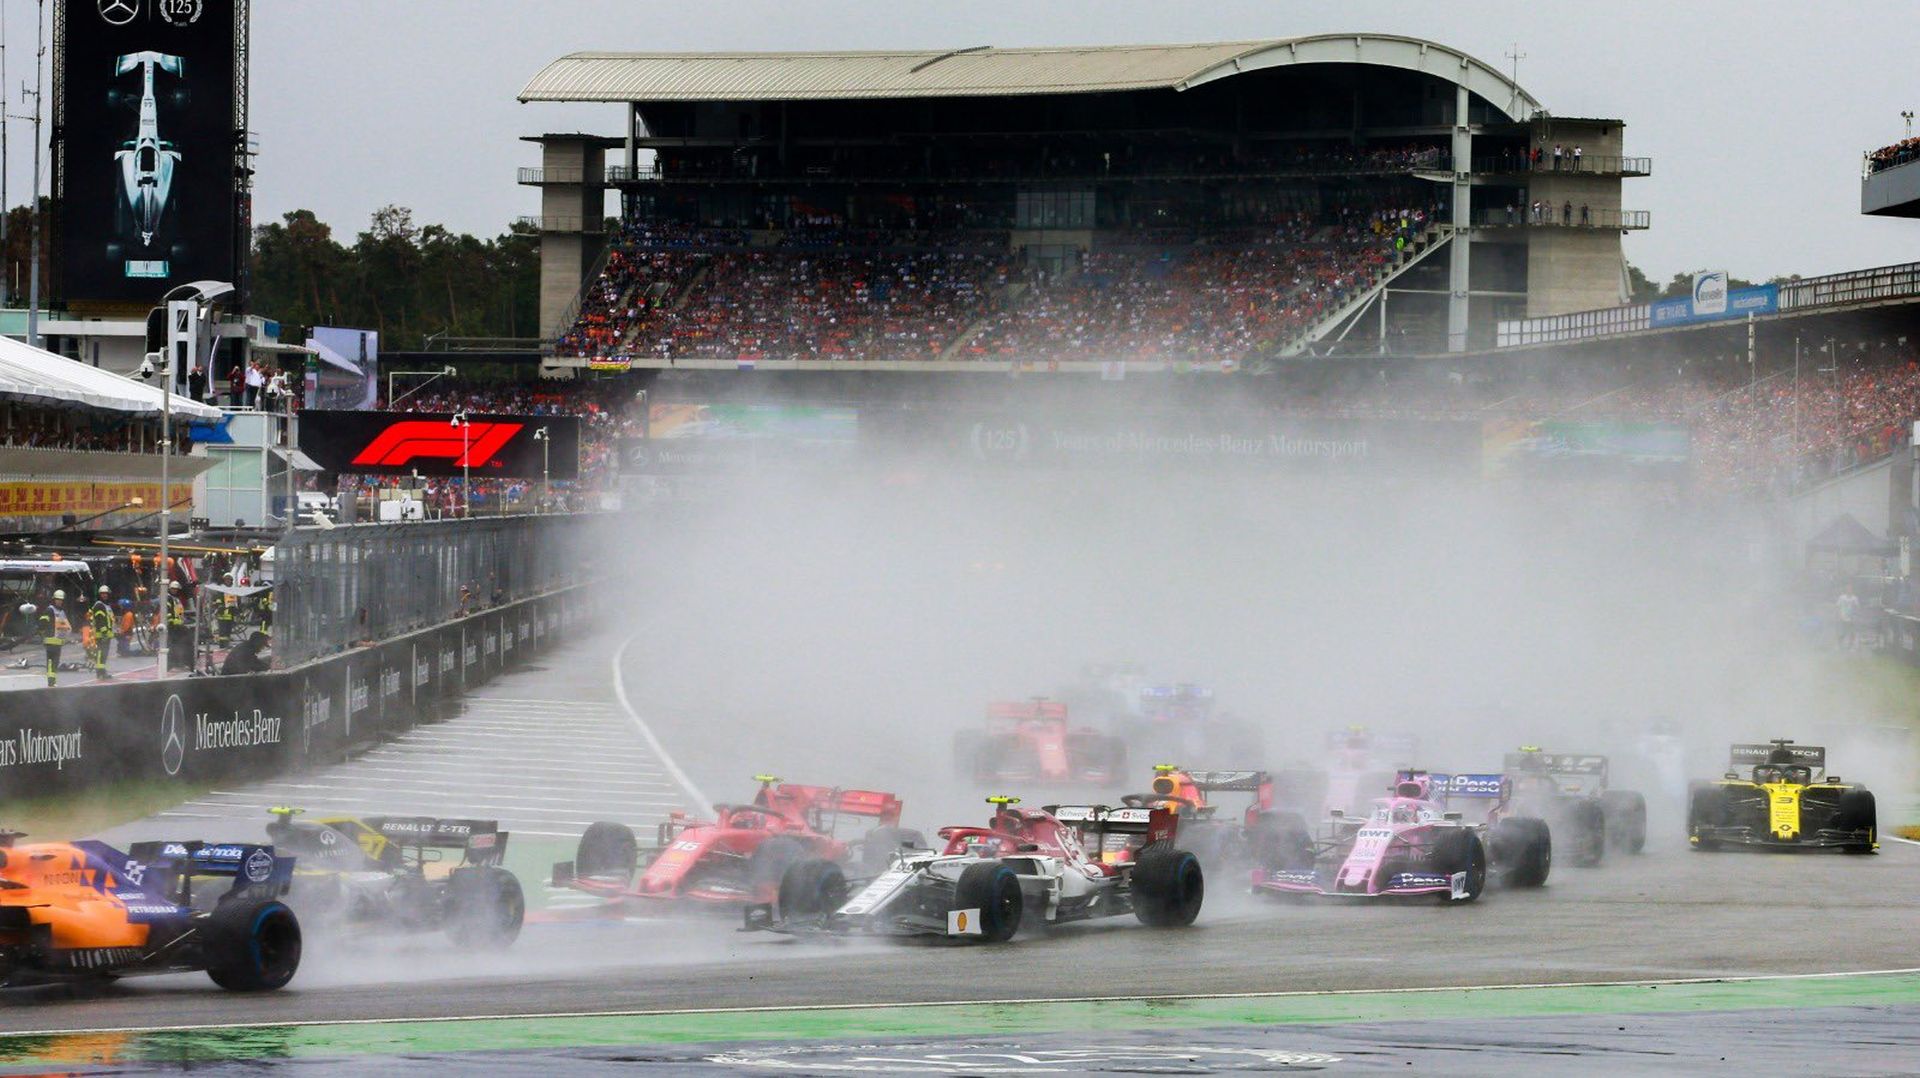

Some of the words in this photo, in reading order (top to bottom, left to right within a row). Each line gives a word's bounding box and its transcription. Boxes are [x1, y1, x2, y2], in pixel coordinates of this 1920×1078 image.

[170, 0, 192, 14] 125
[350, 420, 524, 467] F1
[1268, 434, 1367, 458] Motorsport
[194, 709, 281, 750] Mercedes-Benz
[0, 739, 17, 767] ars
[19, 728, 82, 770] Motorsport
[1775, 796, 1793, 804] 3
[1358, 830, 1391, 838] BWT
[127, 905, 179, 914] PETROBRAS
